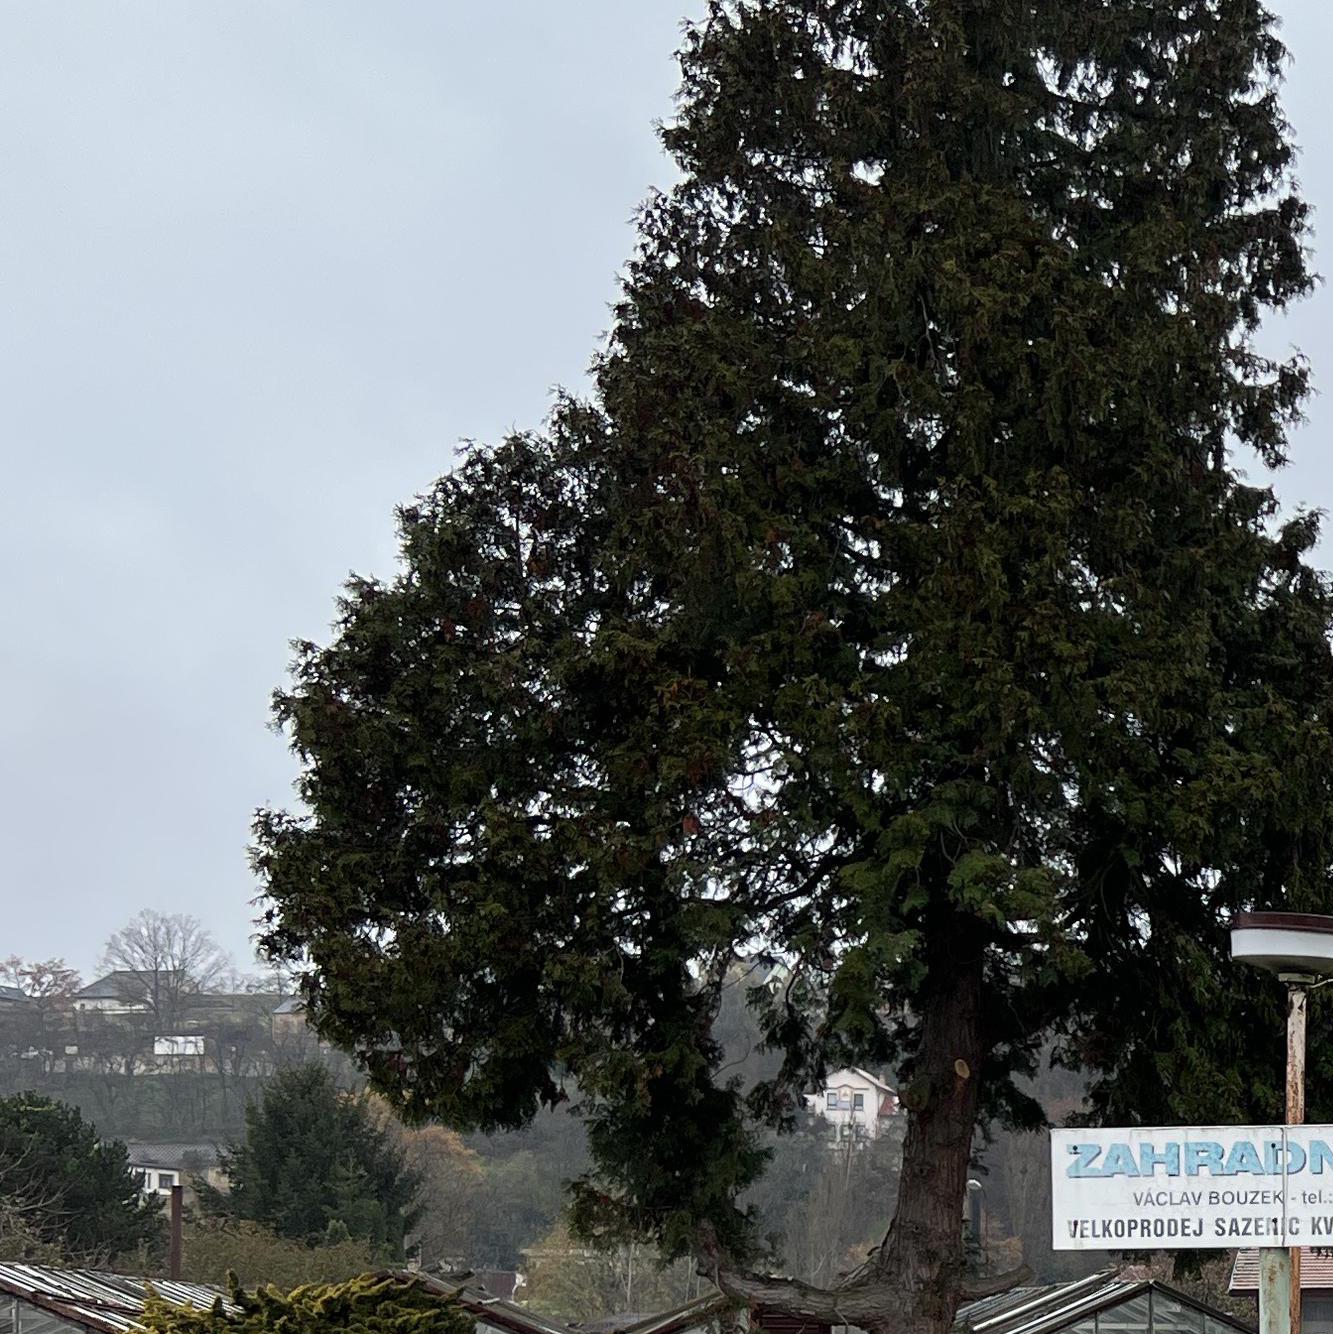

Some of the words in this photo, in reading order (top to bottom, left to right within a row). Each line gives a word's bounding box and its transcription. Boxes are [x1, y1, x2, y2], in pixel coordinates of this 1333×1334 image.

[1133, 1188, 1202, 1206] VÁCLAV
[1208, 1190, 1284, 1205] BOUZEK
[1302, 1190, 1333, 1204] tel.:
[1068, 1218, 1204, 1239] VELKOPRODEJ
